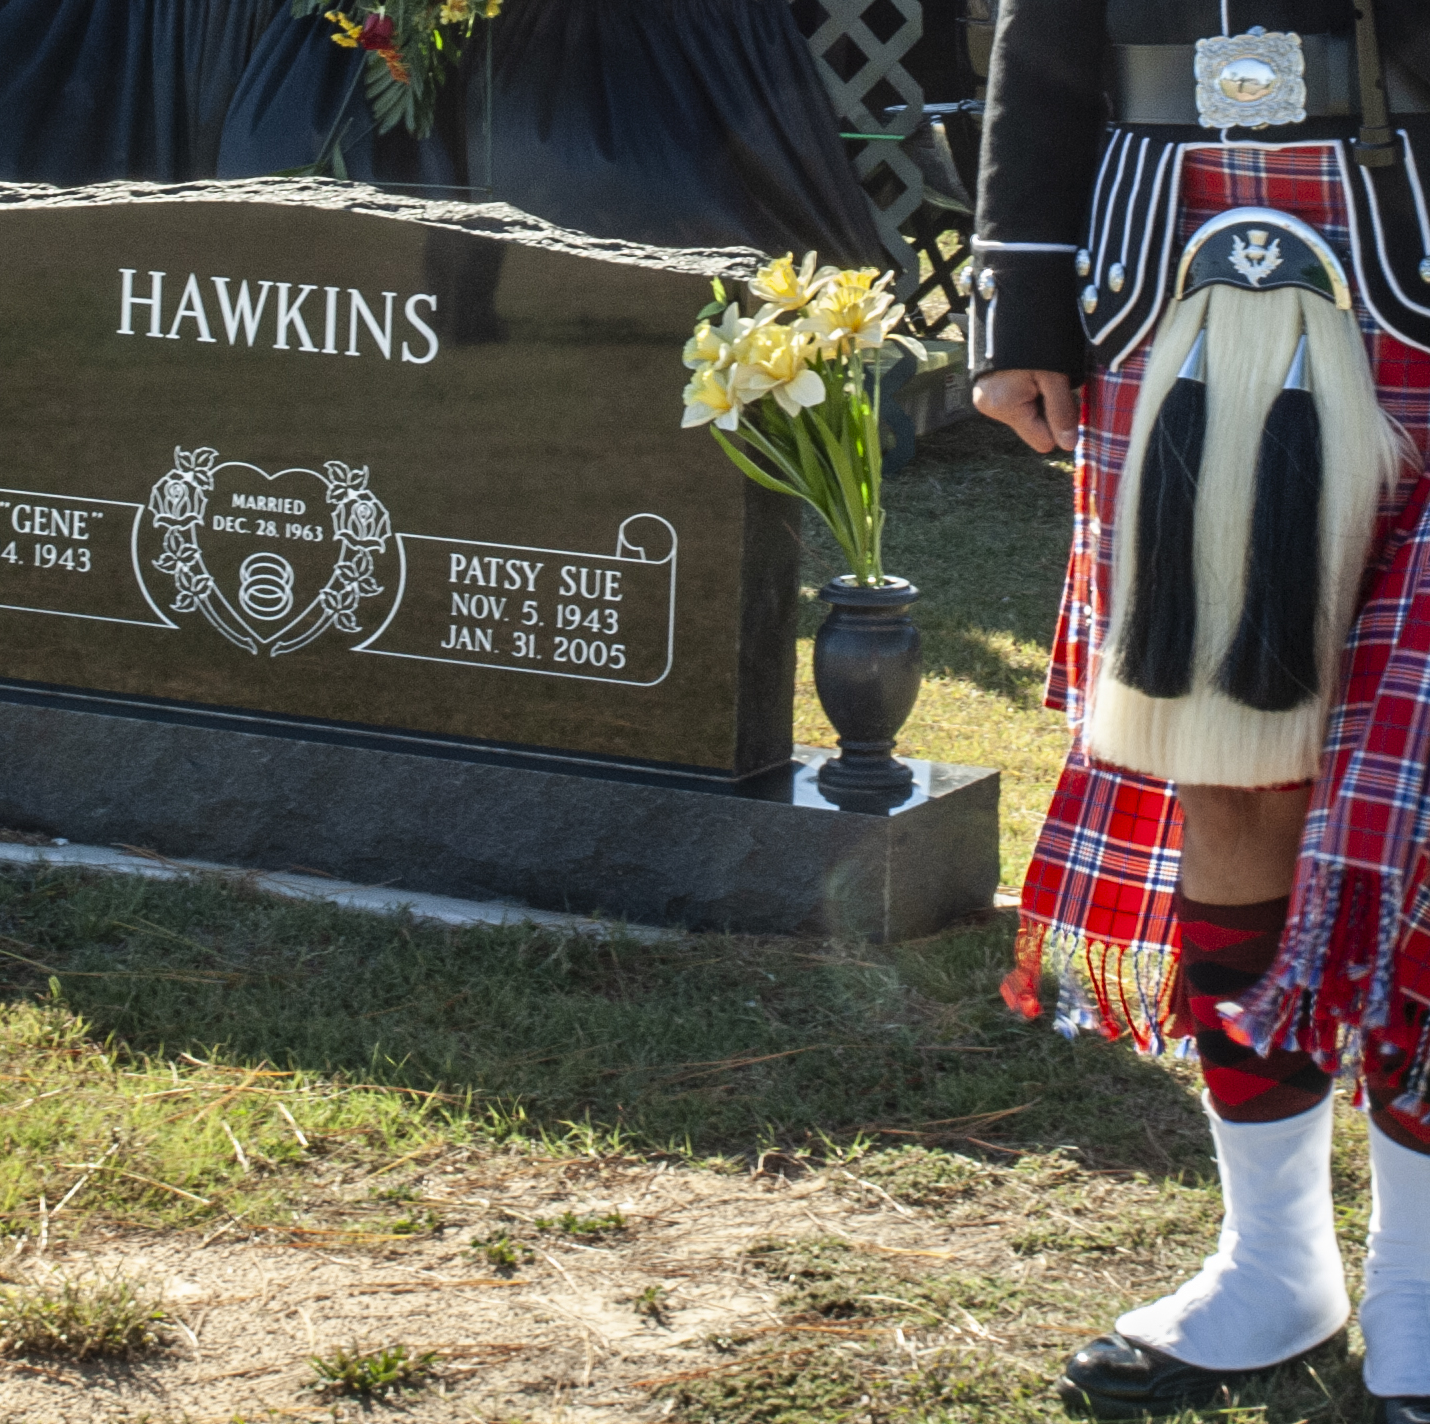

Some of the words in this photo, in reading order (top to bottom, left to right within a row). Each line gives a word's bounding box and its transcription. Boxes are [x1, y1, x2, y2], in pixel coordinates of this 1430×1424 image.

[117, 269, 439, 364] HAWKINS
[231, 493, 306, 515] MARRIED
[285, 523, 323, 541] 1963
[34, 543, 91, 572] 1943
[448, 553, 544, 592] PATSY
[559, 565, 623, 601] SUE
[451, 592, 509, 621] NOV.
[522, 600, 544, 626] 5.
[556, 604, 619, 634] 1943
[441, 625, 499, 653] JAN.
[511, 632, 542, 659] 31.
[553, 636, 626, 669] 2005
